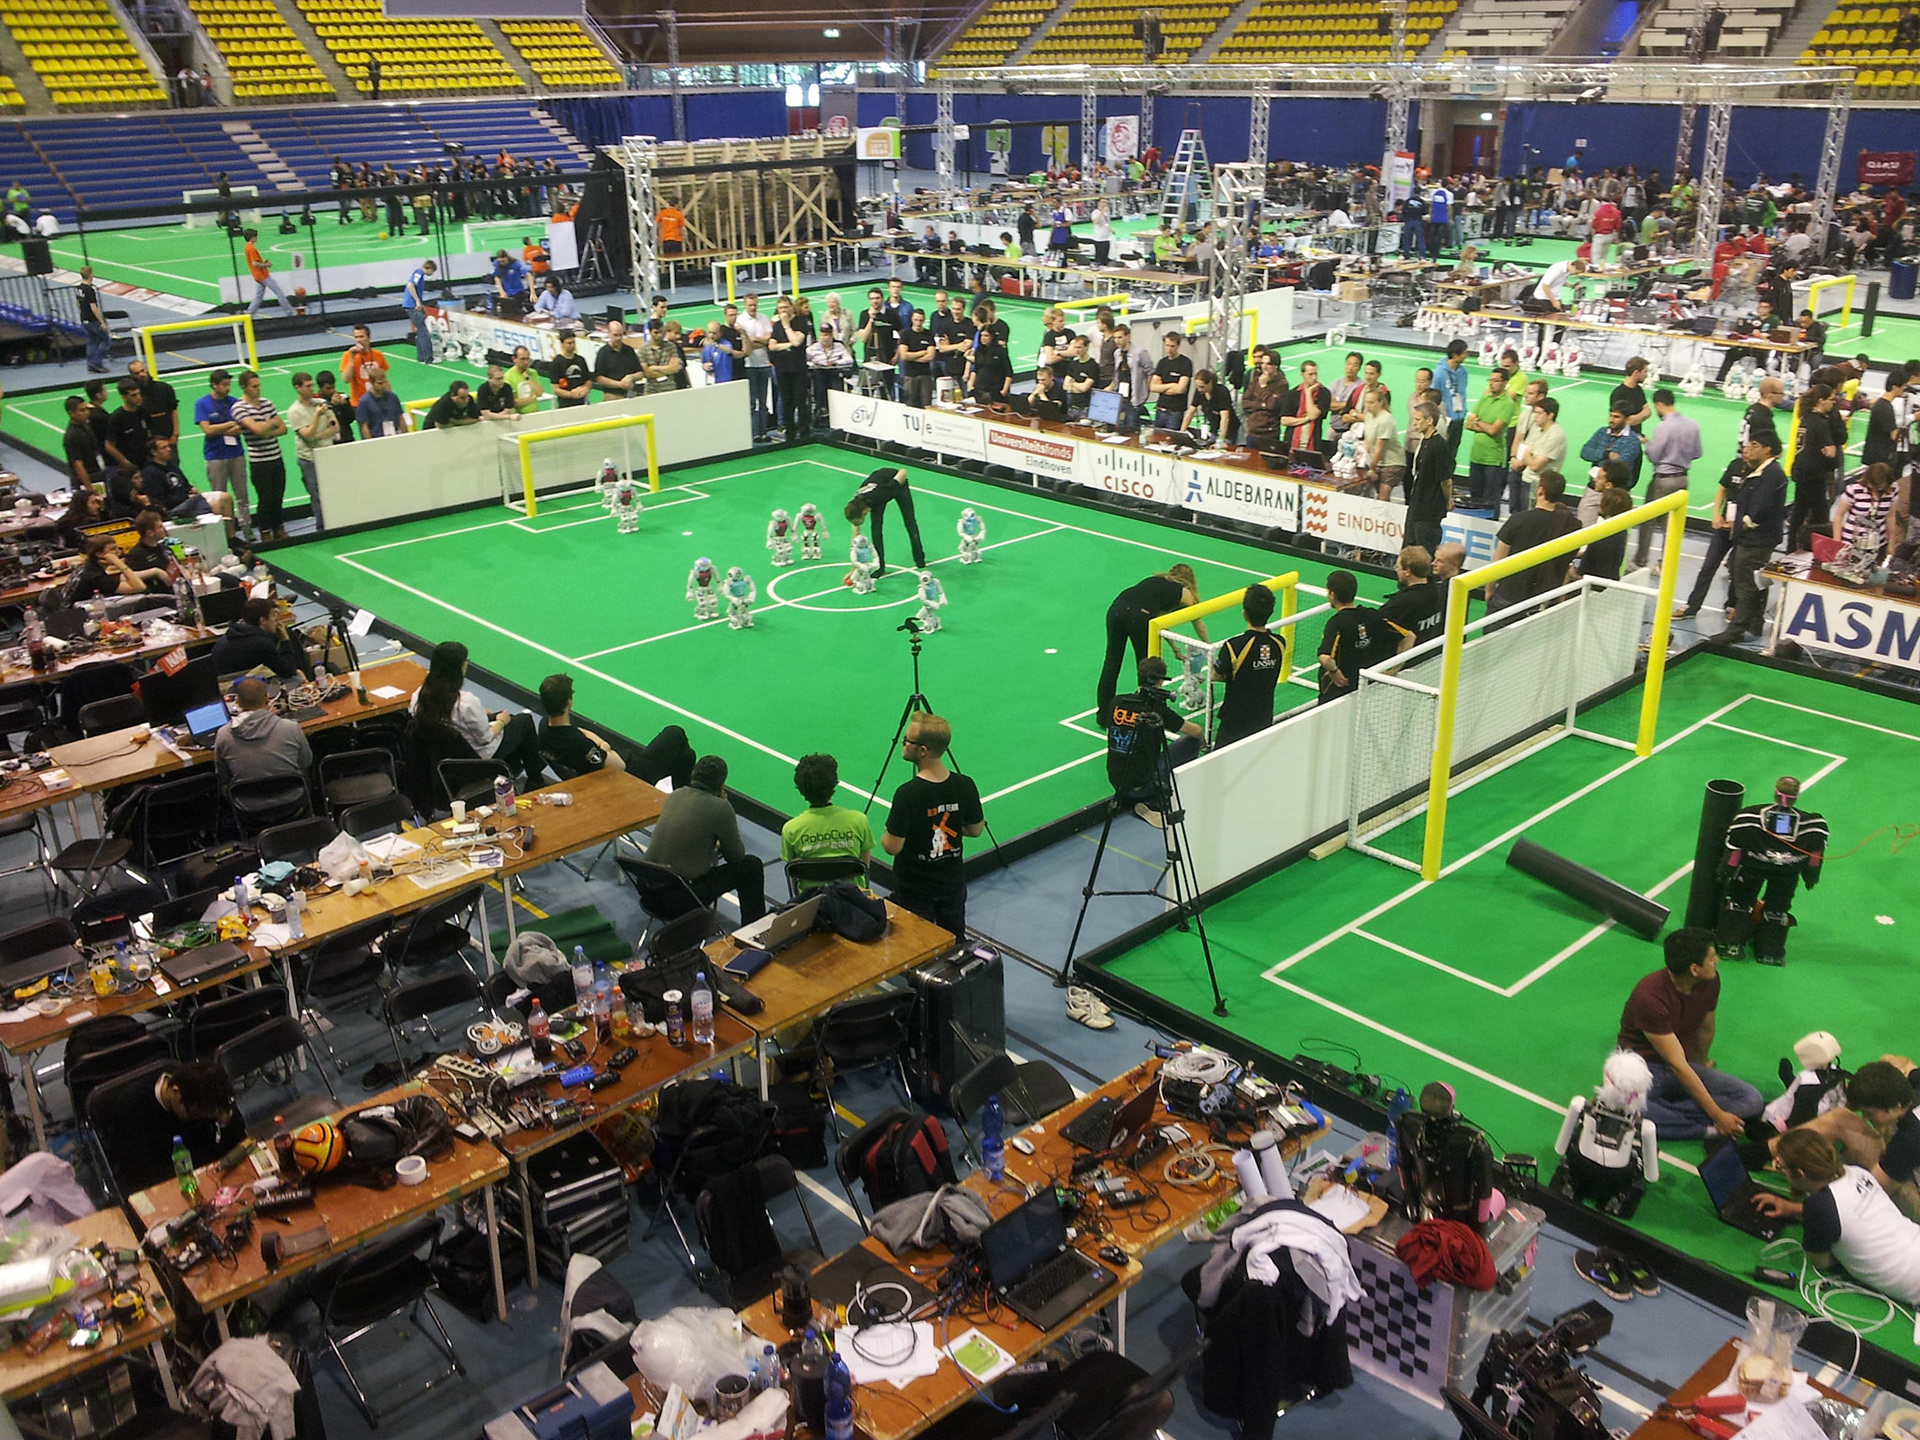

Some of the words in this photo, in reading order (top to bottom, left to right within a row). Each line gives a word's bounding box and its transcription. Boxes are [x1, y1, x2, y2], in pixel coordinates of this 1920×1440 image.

[494, 328, 540, 353] FESTO
[990, 433, 1072, 460] Universiteitsfonds
[1026, 456, 1072, 475] Eindhoven
[1104, 475, 1154, 498] CISCO
[1206, 476, 1294, 512] ALDEBARAN
[1253, 659, 1276, 668] UNSW
[800, 829, 854, 845] RoboCup
